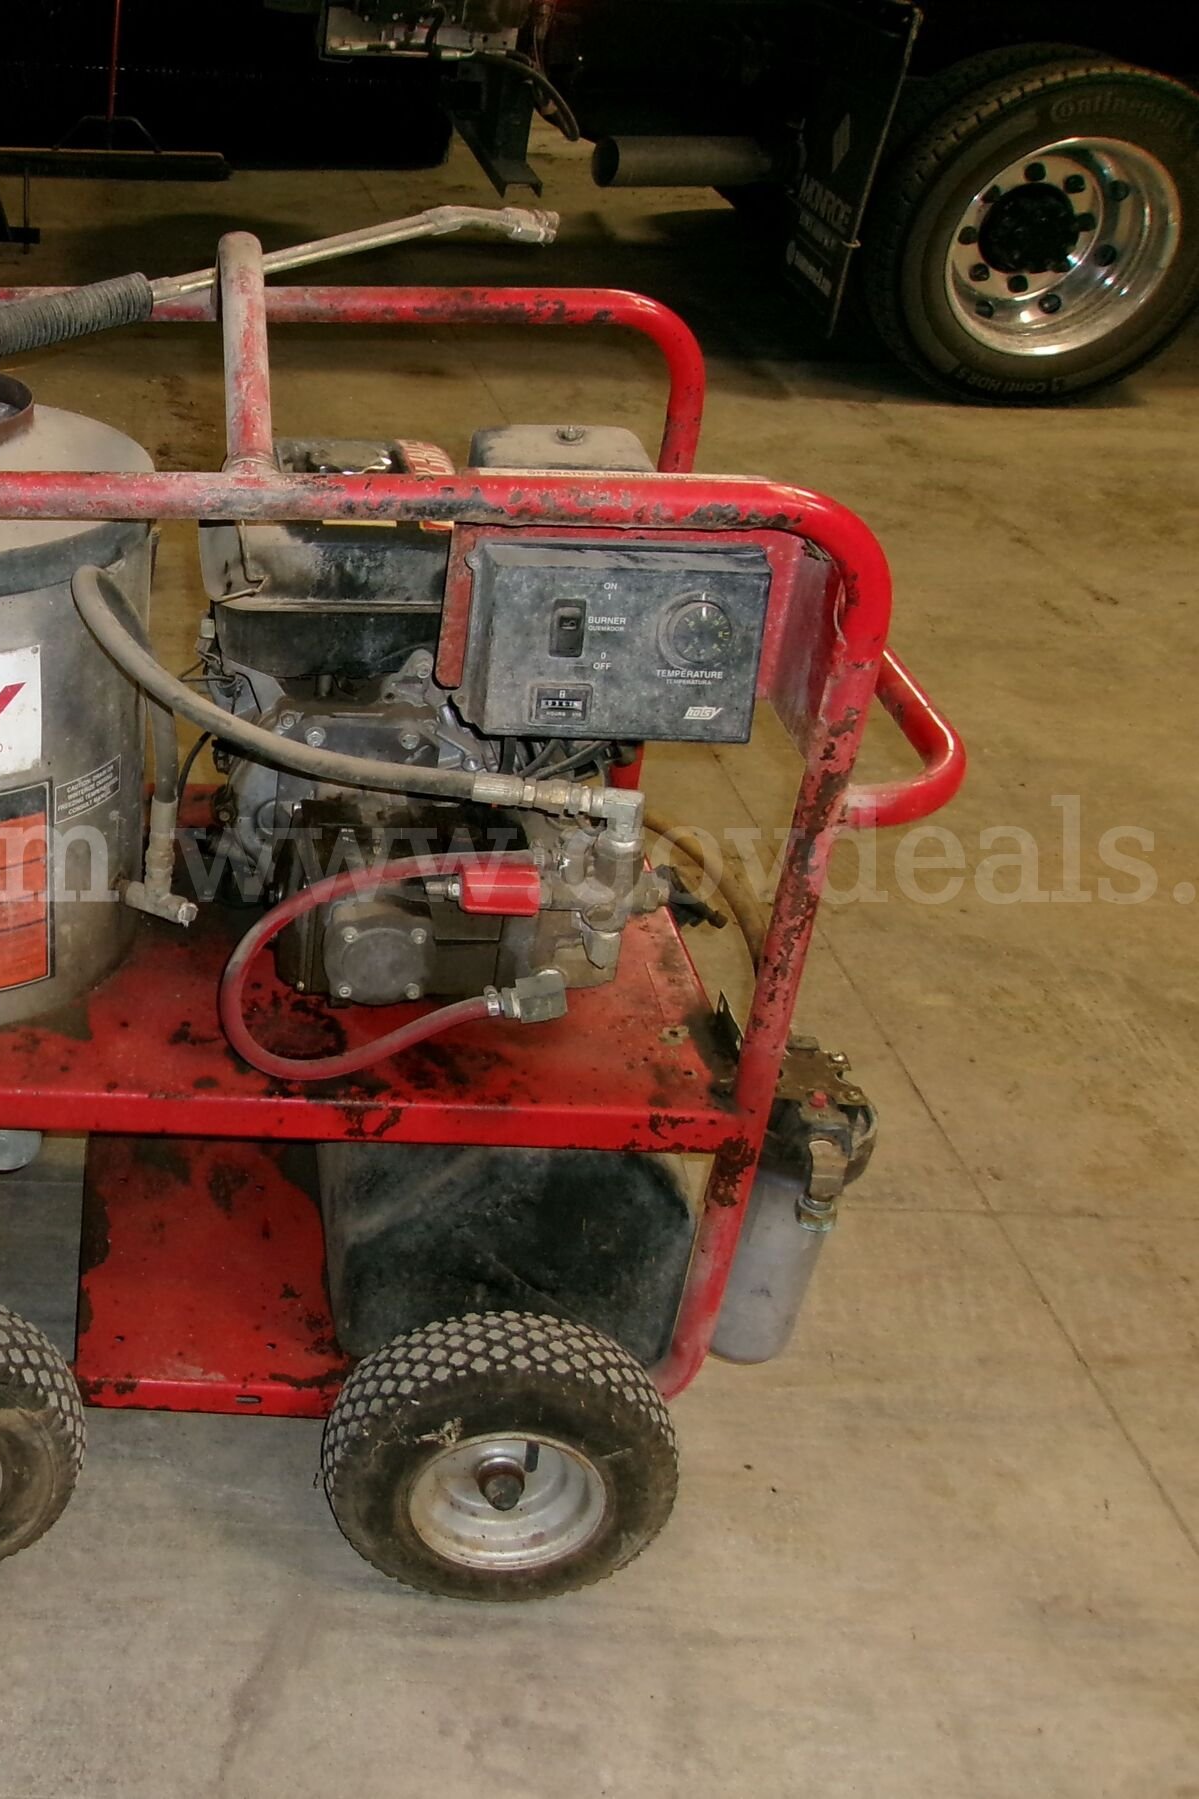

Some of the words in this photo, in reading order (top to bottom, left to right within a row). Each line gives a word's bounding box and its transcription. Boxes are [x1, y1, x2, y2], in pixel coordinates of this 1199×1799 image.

[603, 582, 618, 590] ON
[587, 616, 627, 625] BURNER
[592, 662, 612, 670] OFF
[656, 668, 724, 679] TEMPERATURE
